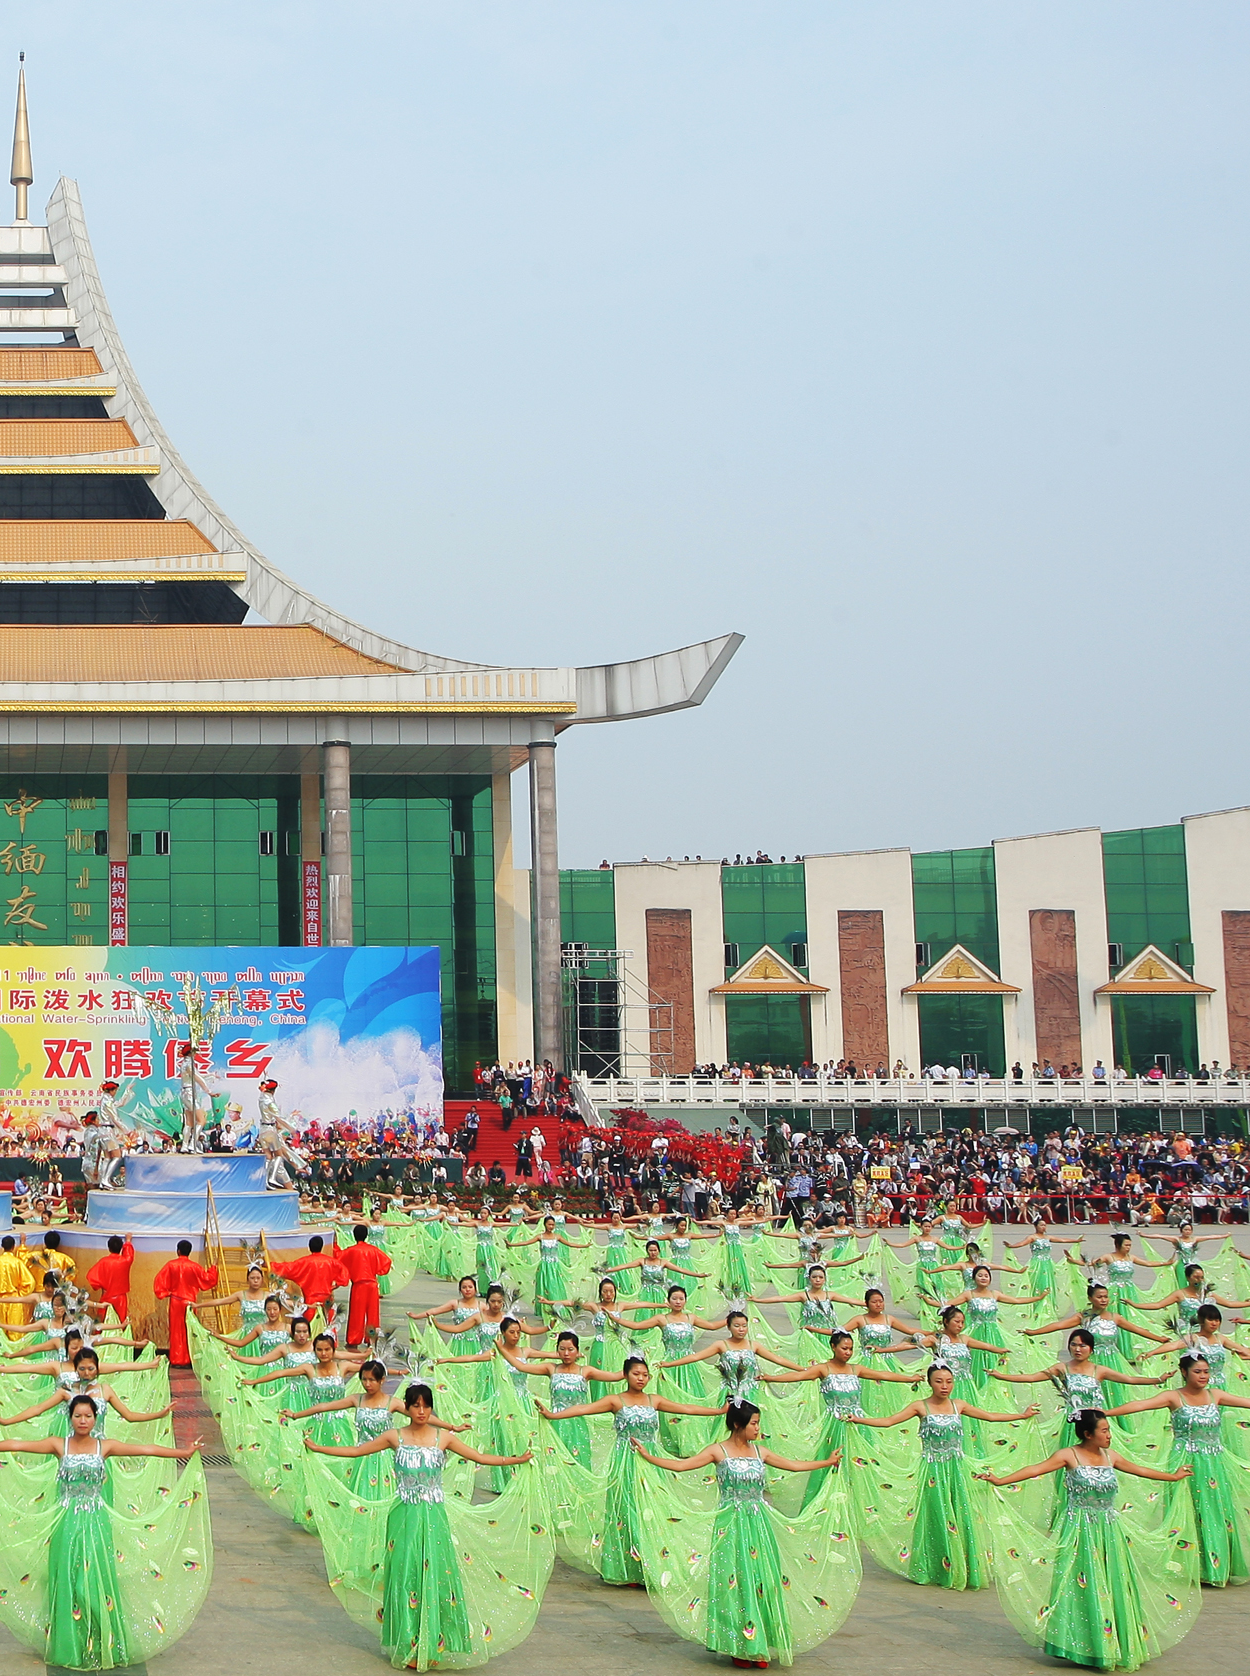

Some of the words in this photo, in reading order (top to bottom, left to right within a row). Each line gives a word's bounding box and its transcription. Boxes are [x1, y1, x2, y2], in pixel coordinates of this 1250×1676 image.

[111, 865, 125, 946] 相约欢乐盛
[306, 864, 319, 946] 热烈欢迎来自世
[270, 1013, 305, 1024] China
